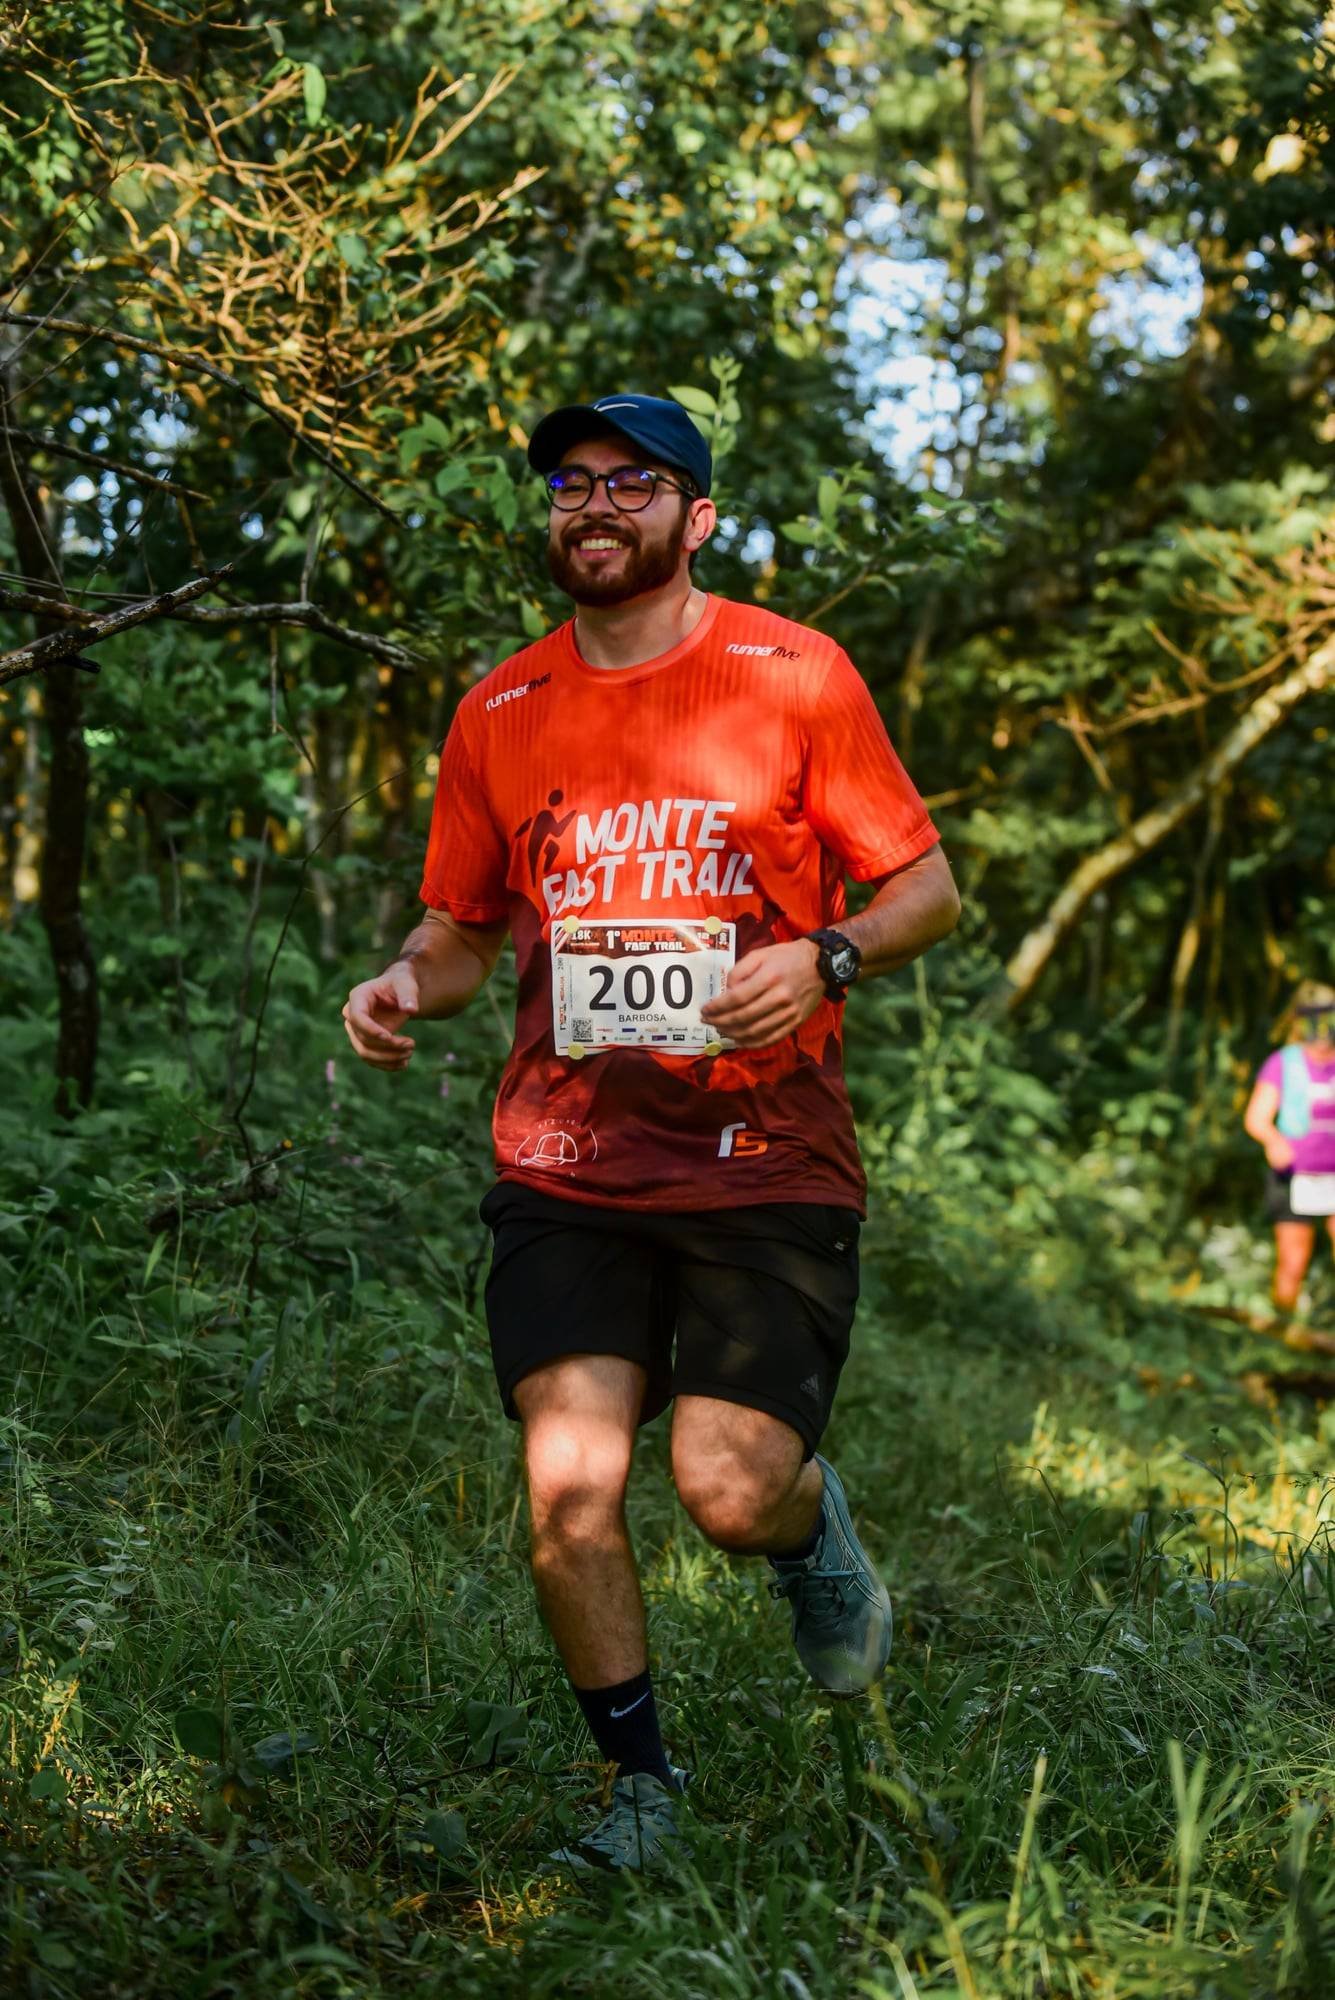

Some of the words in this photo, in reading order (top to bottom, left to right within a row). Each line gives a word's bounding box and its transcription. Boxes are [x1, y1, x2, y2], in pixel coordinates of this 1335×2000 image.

[726, 643, 800, 662] runnerfive
[576, 799, 736, 864] MONTE
[543, 855, 626, 916] FAST
[637, 850, 754, 900] TRAIL
[620, 929, 677, 942] MONTE
[625, 941, 651, 951] FAST
[653, 941, 686, 951] TRAIL
[589, 964, 693, 1010] 200
[618, 1014, 667, 1023] BARBOSA
